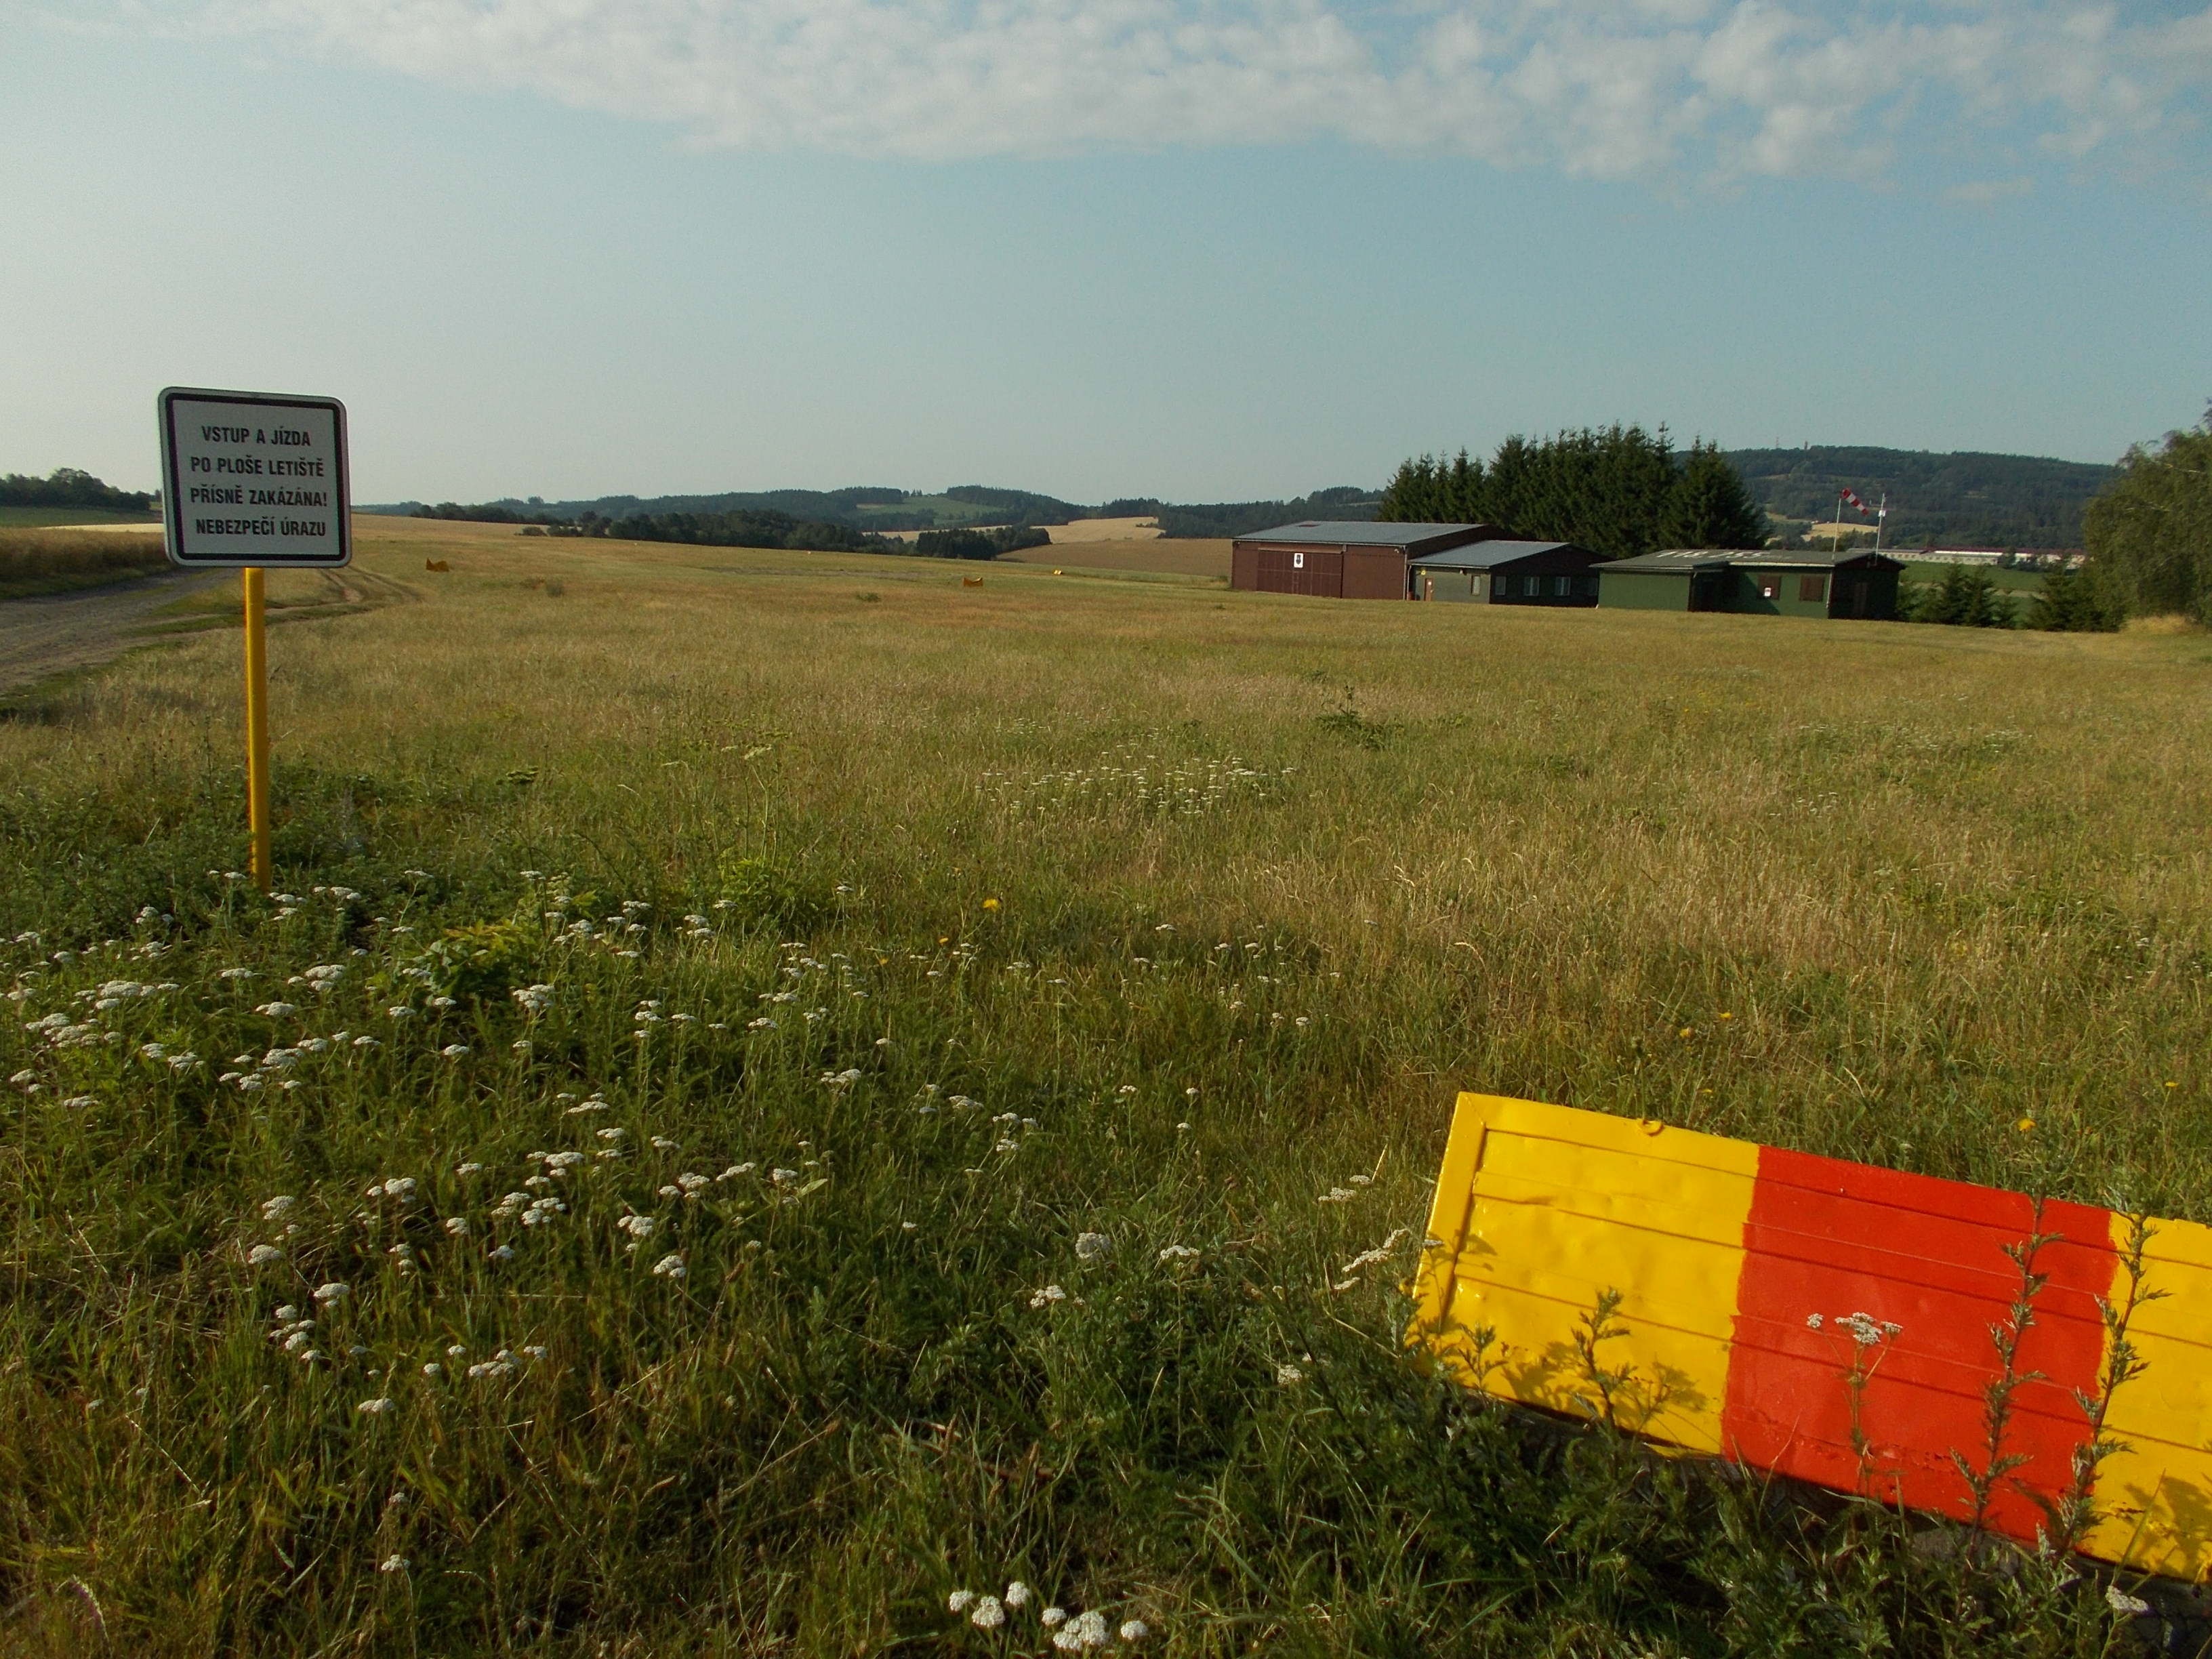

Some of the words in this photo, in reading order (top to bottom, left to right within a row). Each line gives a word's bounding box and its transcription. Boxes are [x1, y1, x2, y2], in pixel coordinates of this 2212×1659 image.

[202, 426, 249, 443] VSTUP
[256, 429, 266, 444] A
[271, 426, 310, 446] JÍZDA
[191, 456, 211, 472] PO
[218, 455, 263, 474] PLOŠE
[269, 456, 324, 476] LETIŠTĚ
[190, 484, 243, 504] PŘÍSNĚ
[249, 486, 327, 507] ZAKÁZÁNA!
[196, 516, 275, 535] NEBEZPEČÍ
[281, 516, 326, 536] ÚRAZU
